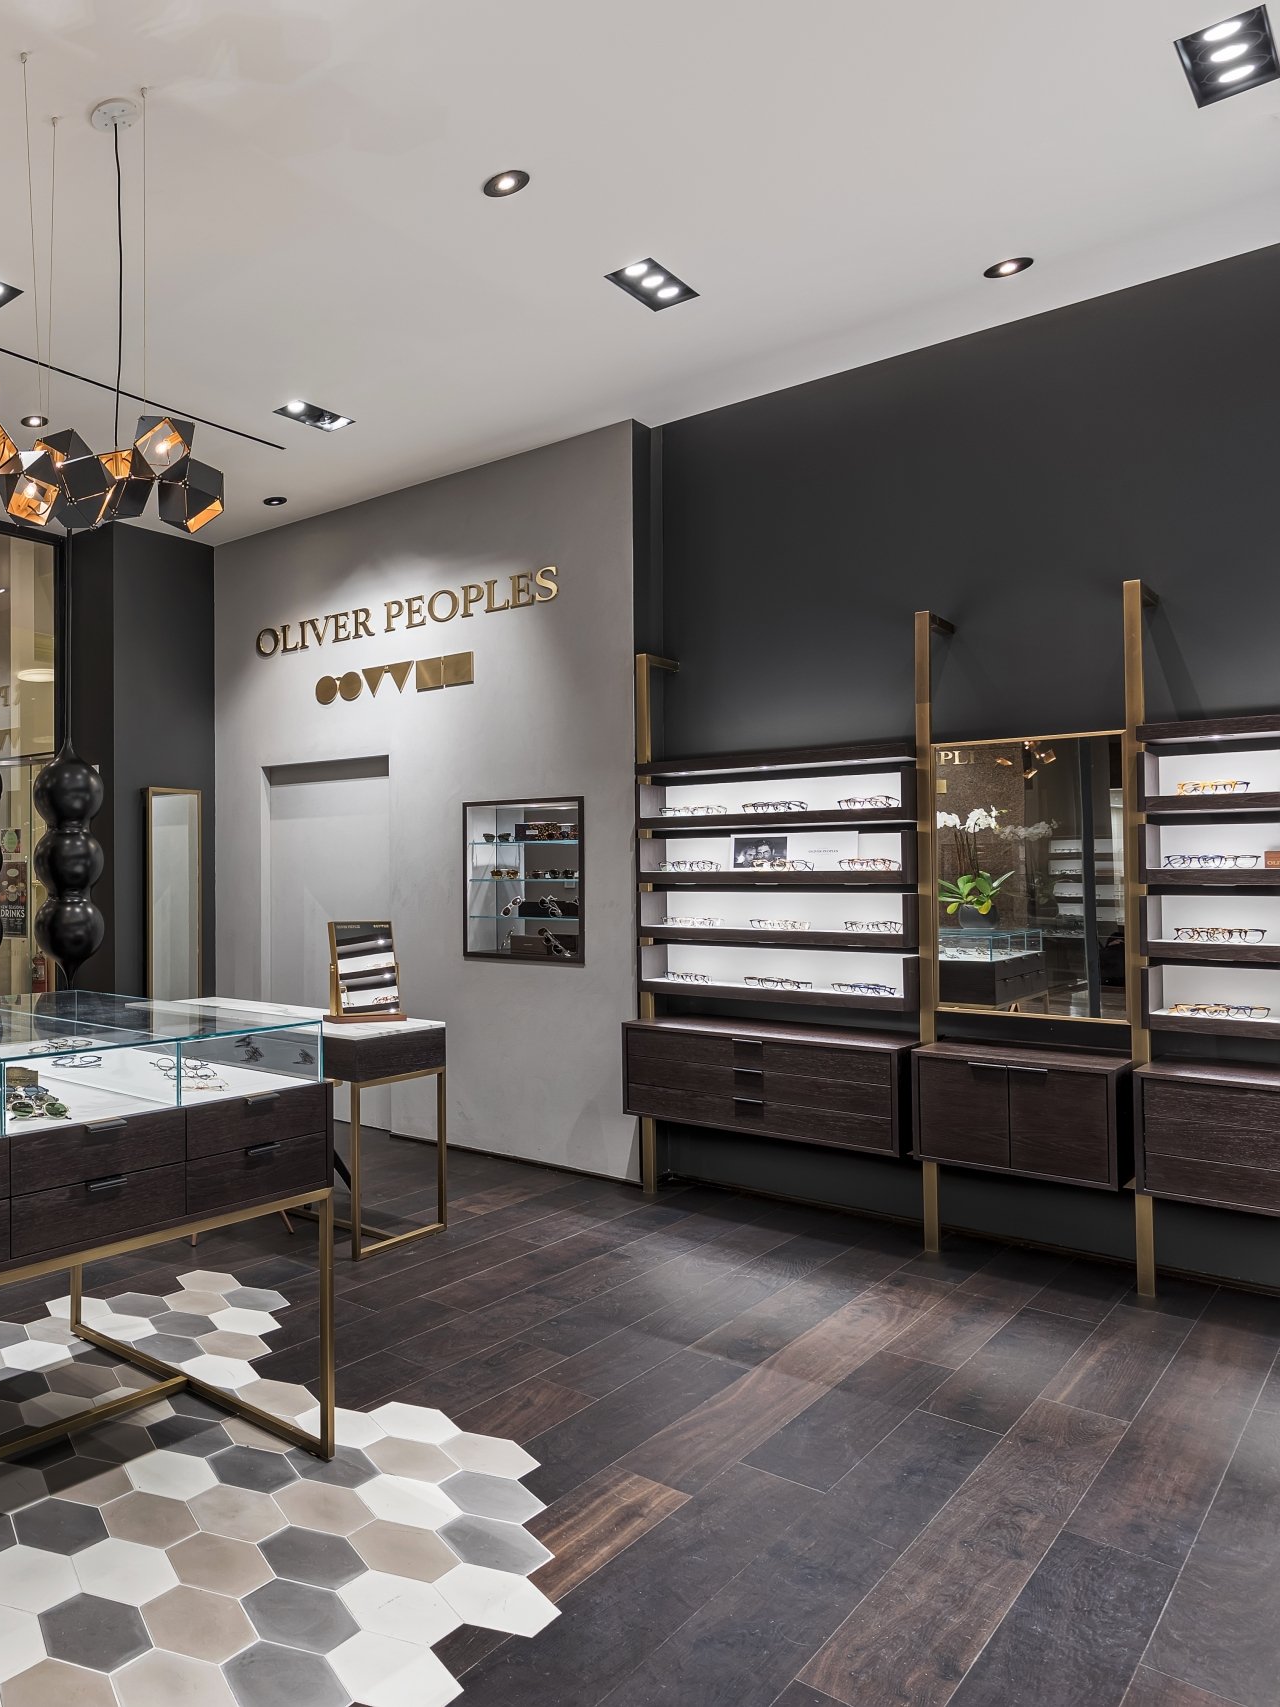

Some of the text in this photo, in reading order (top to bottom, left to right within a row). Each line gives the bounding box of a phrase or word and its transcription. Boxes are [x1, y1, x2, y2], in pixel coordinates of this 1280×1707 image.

[256, 566, 559, 657] OLIVER PEOPLES
[0, 910, 25, 918] DRINKS
